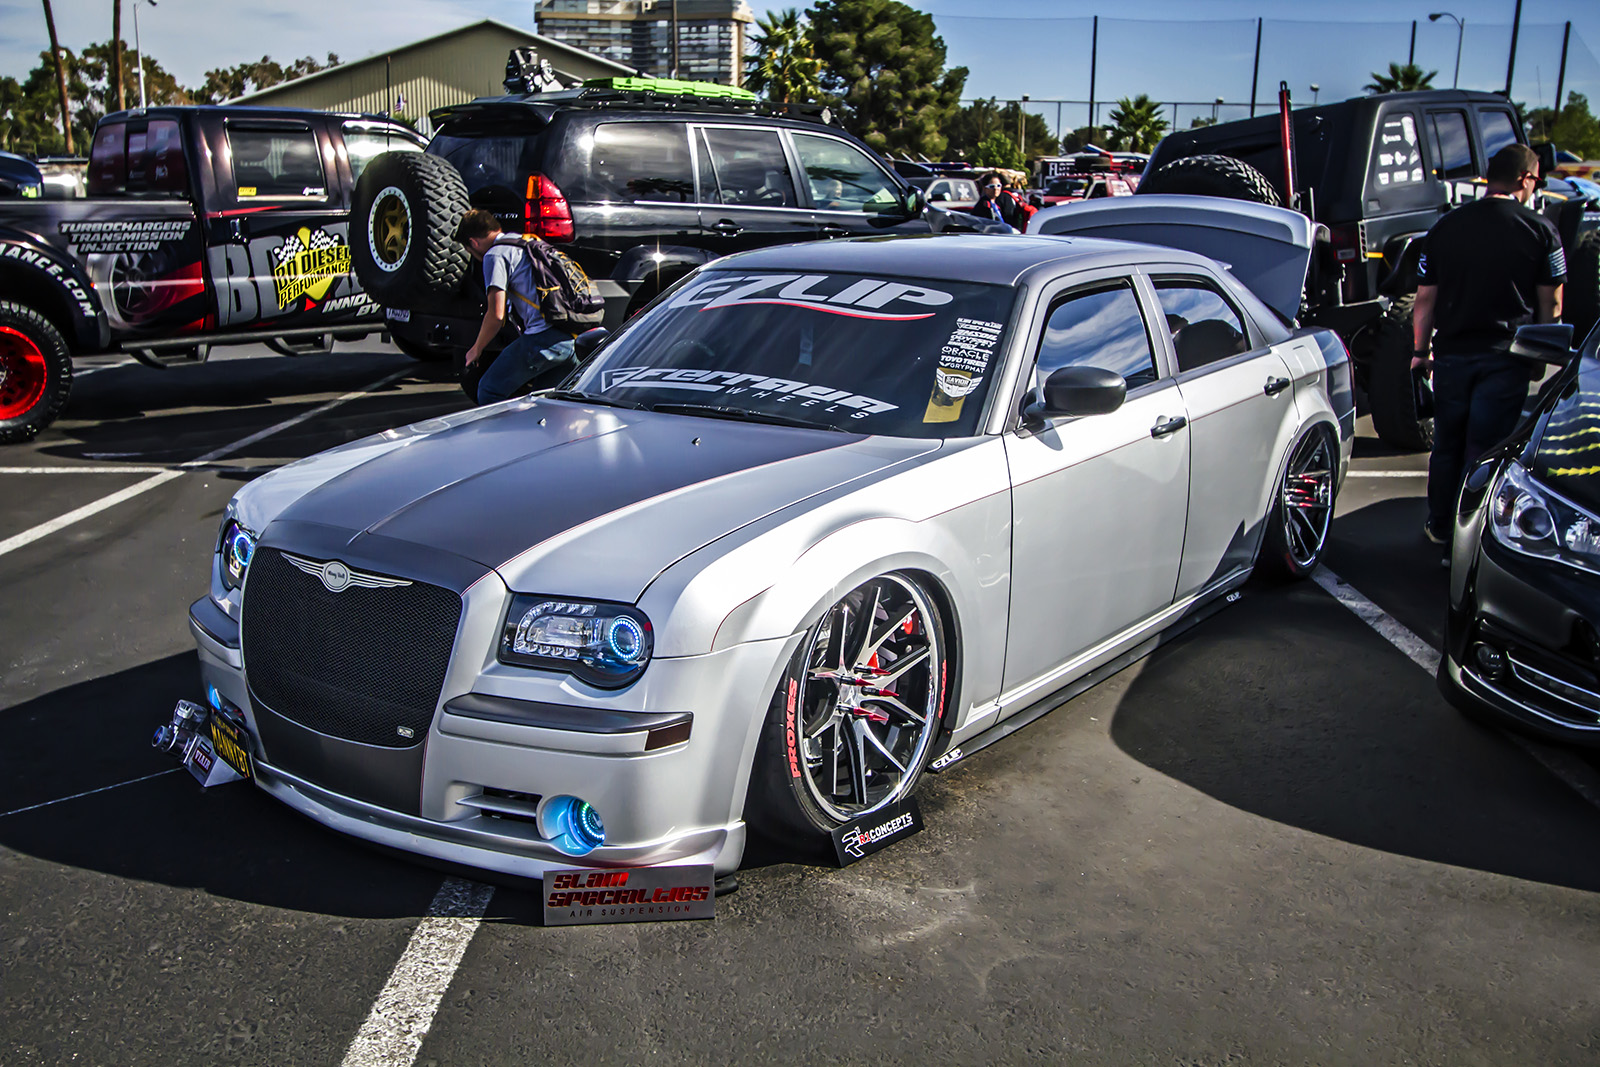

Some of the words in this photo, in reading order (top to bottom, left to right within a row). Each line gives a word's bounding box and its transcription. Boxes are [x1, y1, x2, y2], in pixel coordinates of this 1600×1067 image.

[60, 221, 191, 232] TURBOCHARGERS
[71, 231, 185, 242] TRANSMISSION
[80, 241, 160, 252] INJECTION
[276, 260, 298, 292] BD
[301, 246, 349, 275] DIESEL
[0, 243, 96, 317] ANCE.COM
[279, 262, 349, 308] PERFORMANCE
[668, 274, 953, 310] EZLIP
[356, 303, 380, 316] BY
[941, 355, 962, 363] TOYO
[963, 358, 987, 367] TIRES
[942, 346, 989, 360] ORACLE
[726, 386, 870, 419] WHEELS
[786, 677, 801, 778] PROXES
[194, 750, 211, 771] VIAIR
[570, 909, 593, 917] AIR
[602, 905, 691, 916] SUSPENSION
